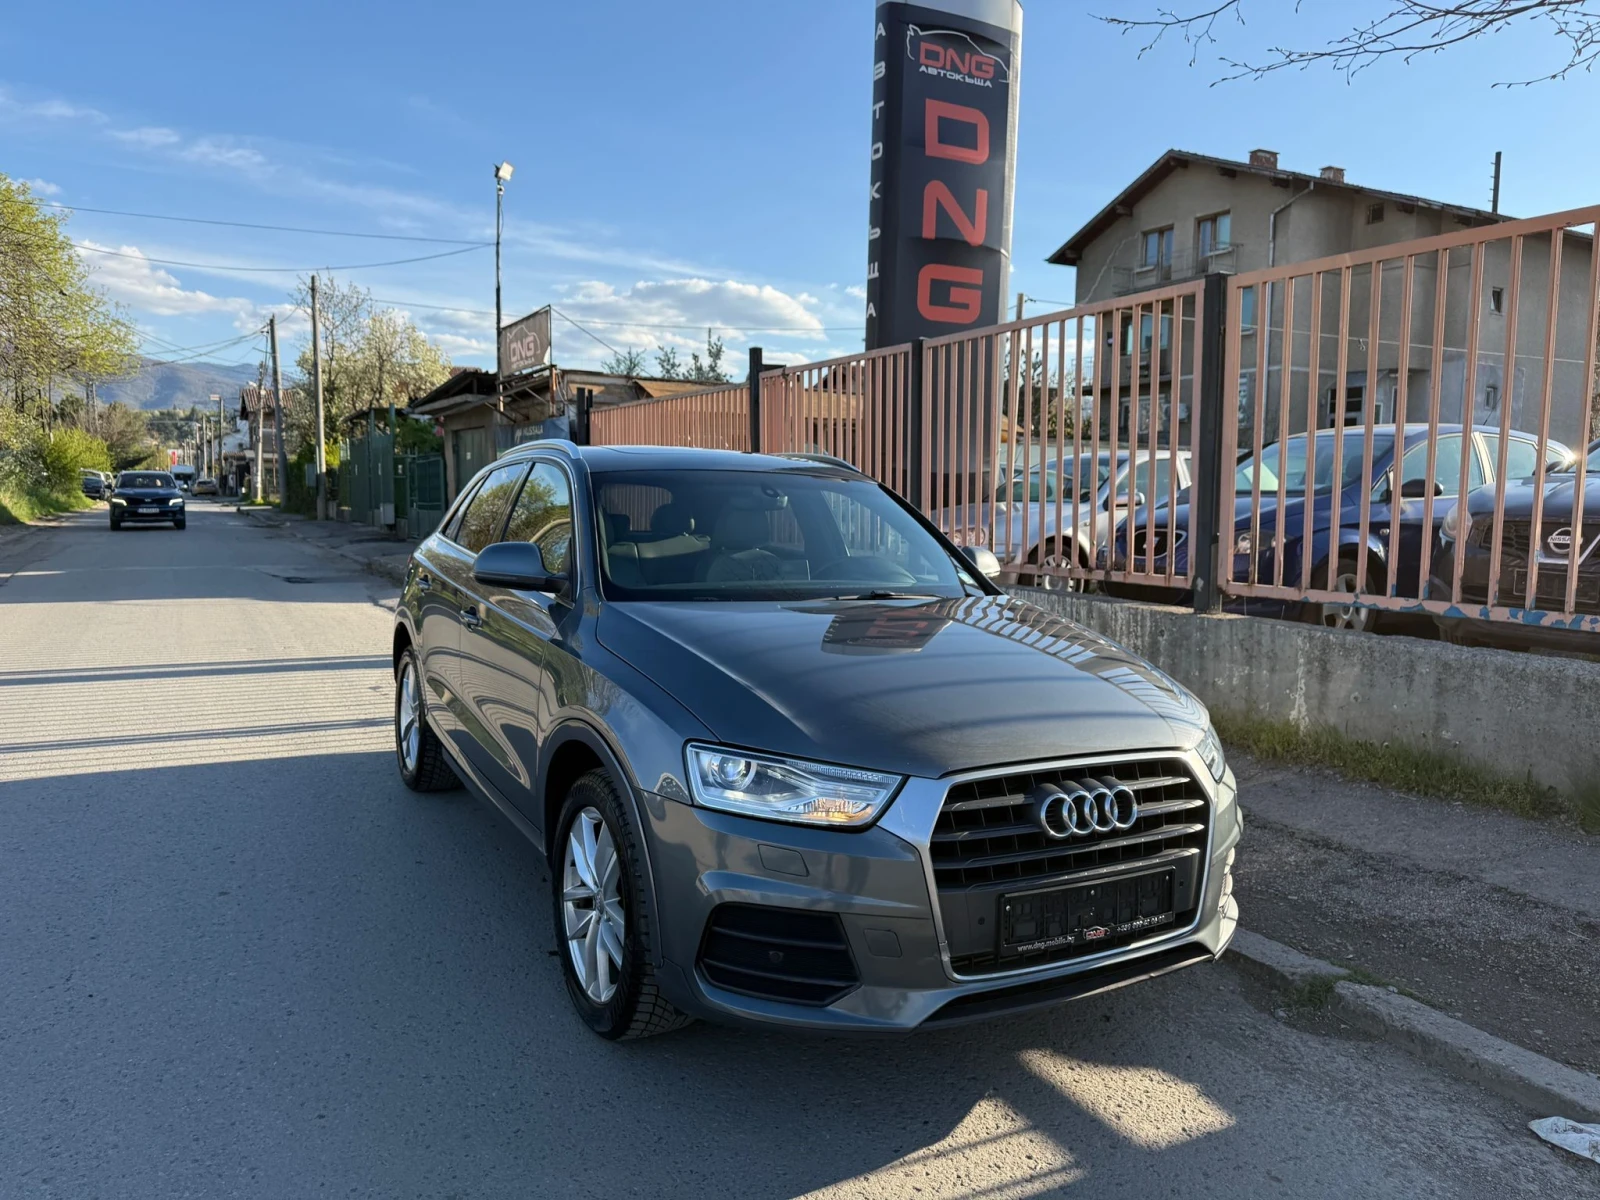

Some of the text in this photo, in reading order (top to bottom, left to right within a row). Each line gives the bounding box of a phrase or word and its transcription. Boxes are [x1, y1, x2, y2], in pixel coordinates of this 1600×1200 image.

[919, 41, 995, 79] DNG
[917, 98, 990, 325] DNG
[510, 335, 535, 362] DNG
